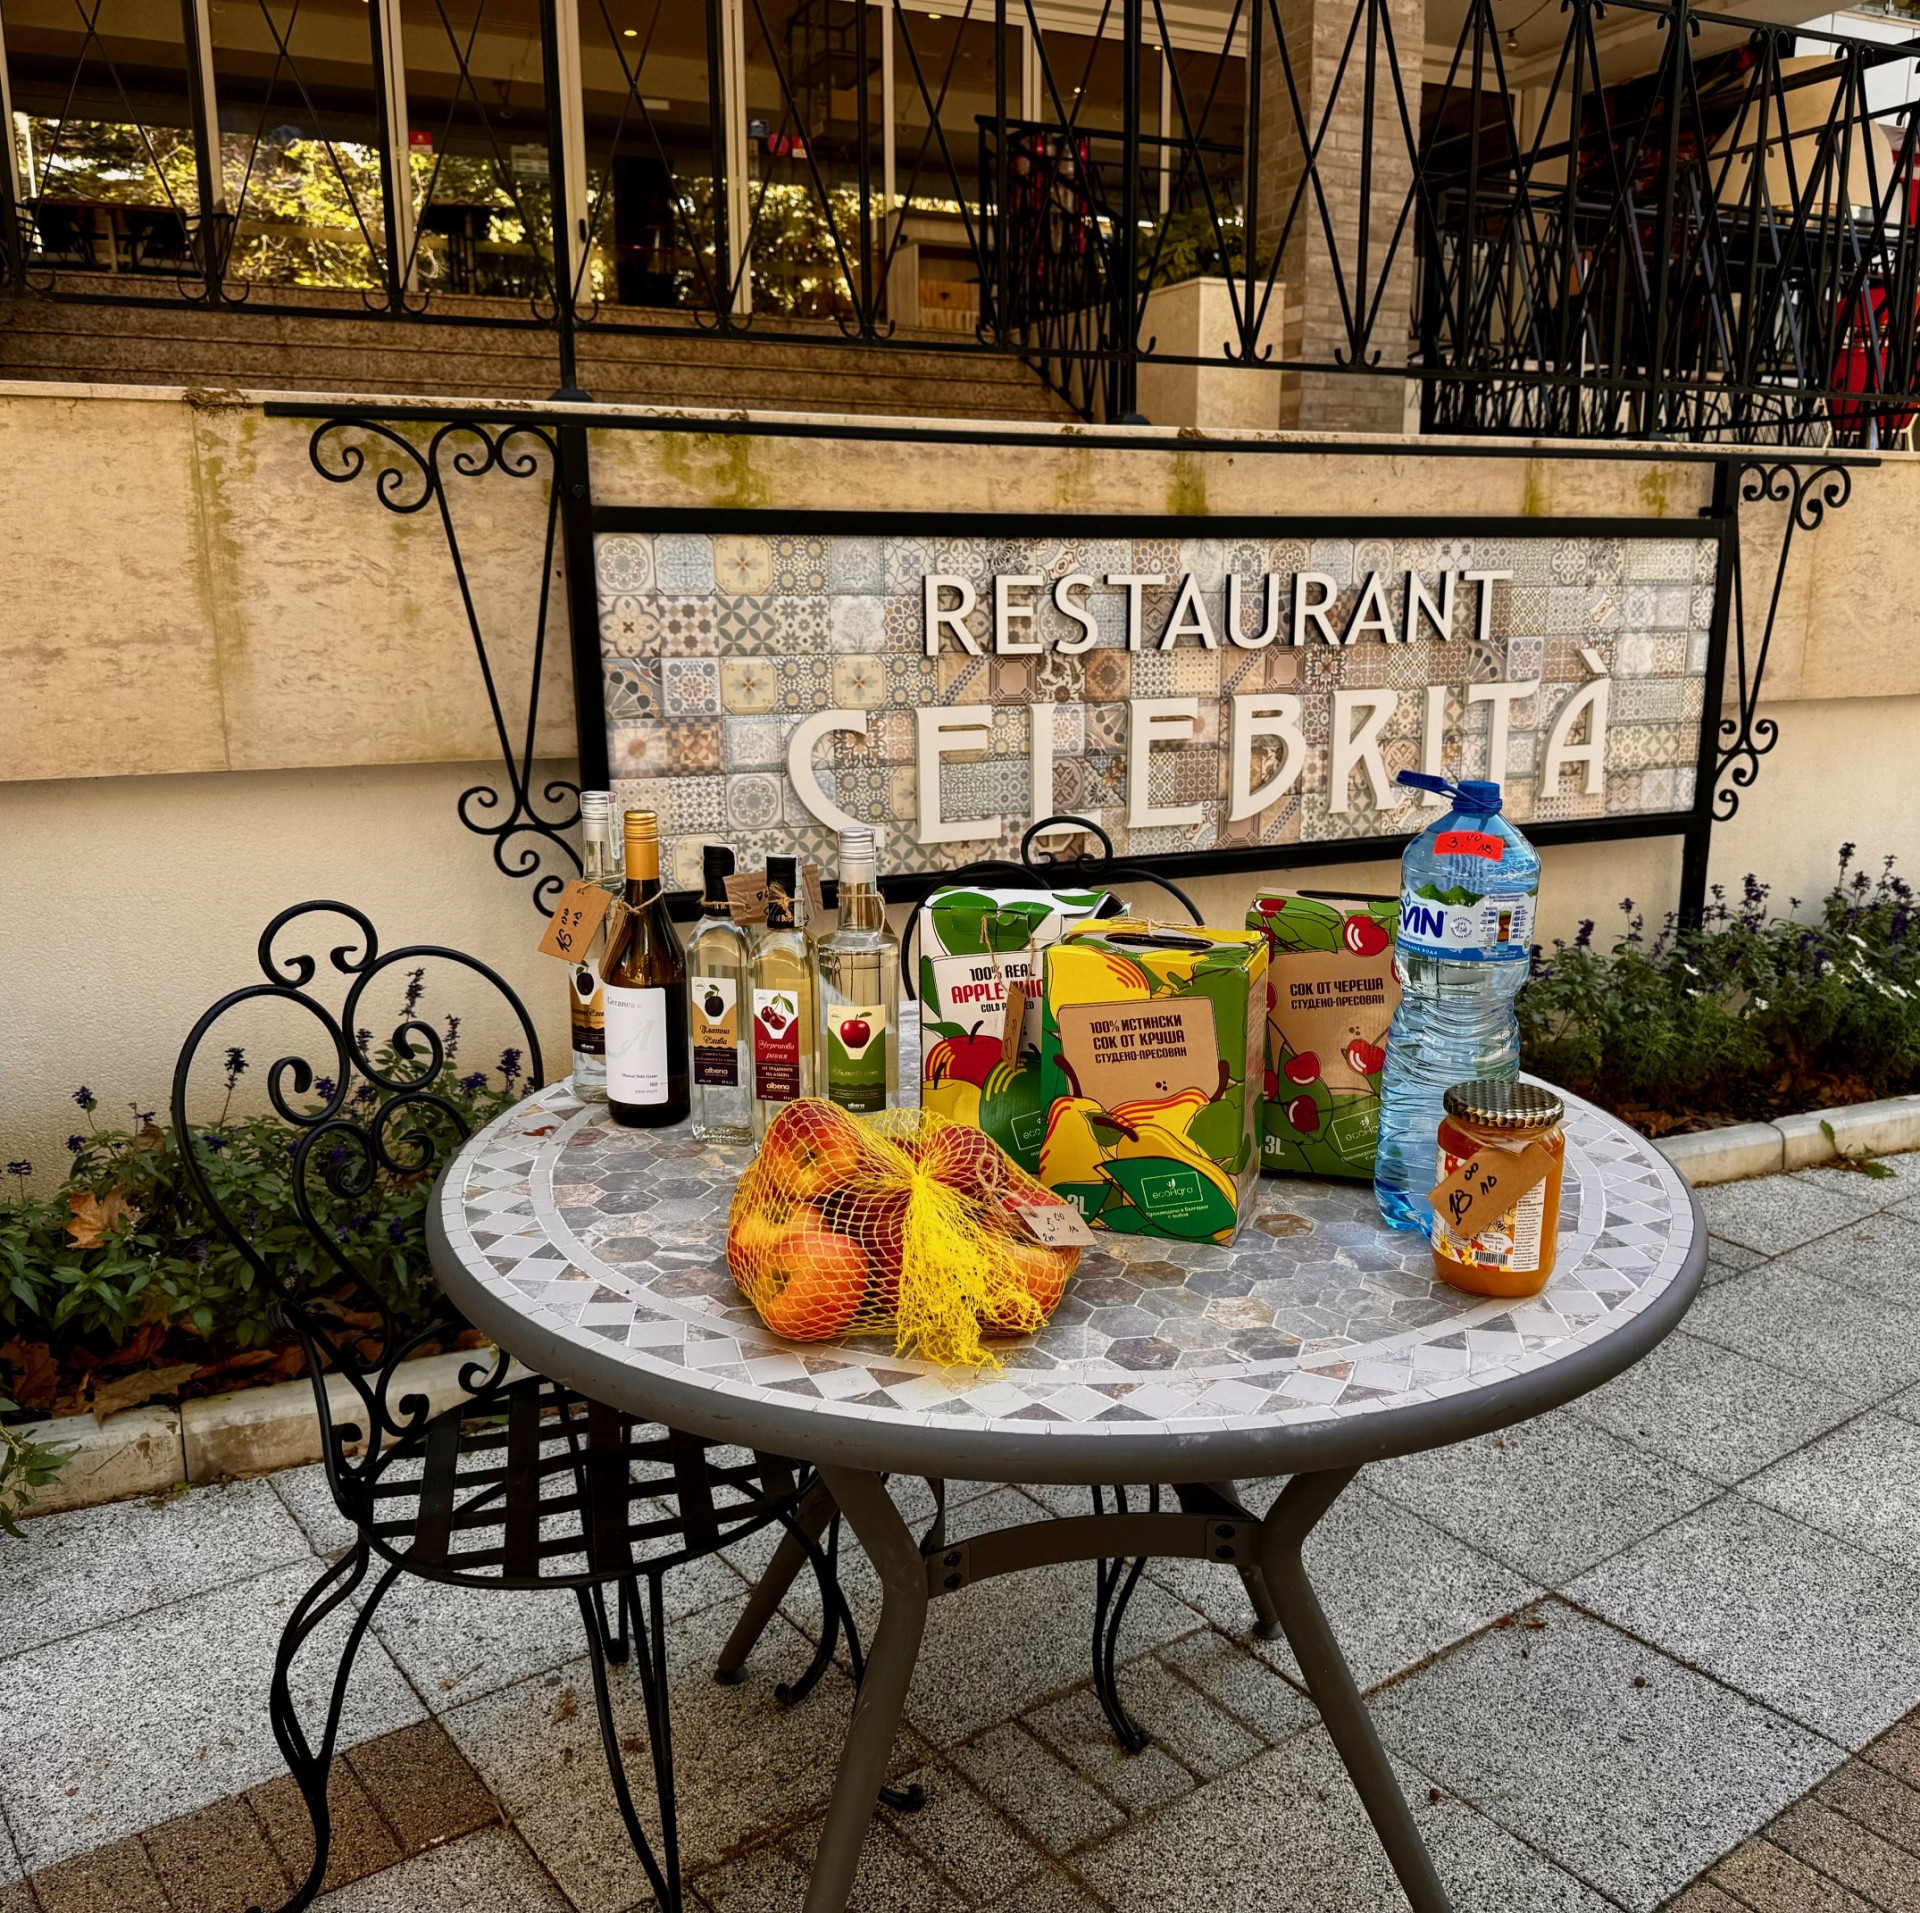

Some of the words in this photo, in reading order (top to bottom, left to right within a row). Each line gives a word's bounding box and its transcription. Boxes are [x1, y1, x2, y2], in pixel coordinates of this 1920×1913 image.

[923, 569, 1513, 656] RESTAURANT
[786, 649, 1612, 848] CELEBRITÀ
[969, 965, 1002, 982] 100%
[1004, 963, 1036, 978] REAL
[951, 981, 1005, 1004] APPLE
[1290, 982, 1314, 997] СОК
[1316, 981, 1332, 995] ОТ
[1333, 977, 1384, 993] ЧЕРЕША
[981, 1002, 1000, 1013] COLD
[1291, 994, 1385, 1011] СТУДЕНО-ПРЕСОВАН
[1089, 1020, 1120, 1034] 100%
[1121, 1014, 1183, 1032] ИСТИНСКИ
[1092, 1035, 1118, 1050] СОК
[1120, 1034, 1135, 1048] ОТ
[1139, 1029, 1186, 1046] КРУША
[1094, 1046, 1188, 1064] СТУДЕНО-ПРЕСОВАН
[704, 1066, 728, 1075] albena
[766, 1081, 790, 1090] albena
[1264, 1135, 1286, 1155] 3L
[1152, 1187, 1194, 1200] ecoAgro
[1066, 1194, 1089, 1215] 3L
